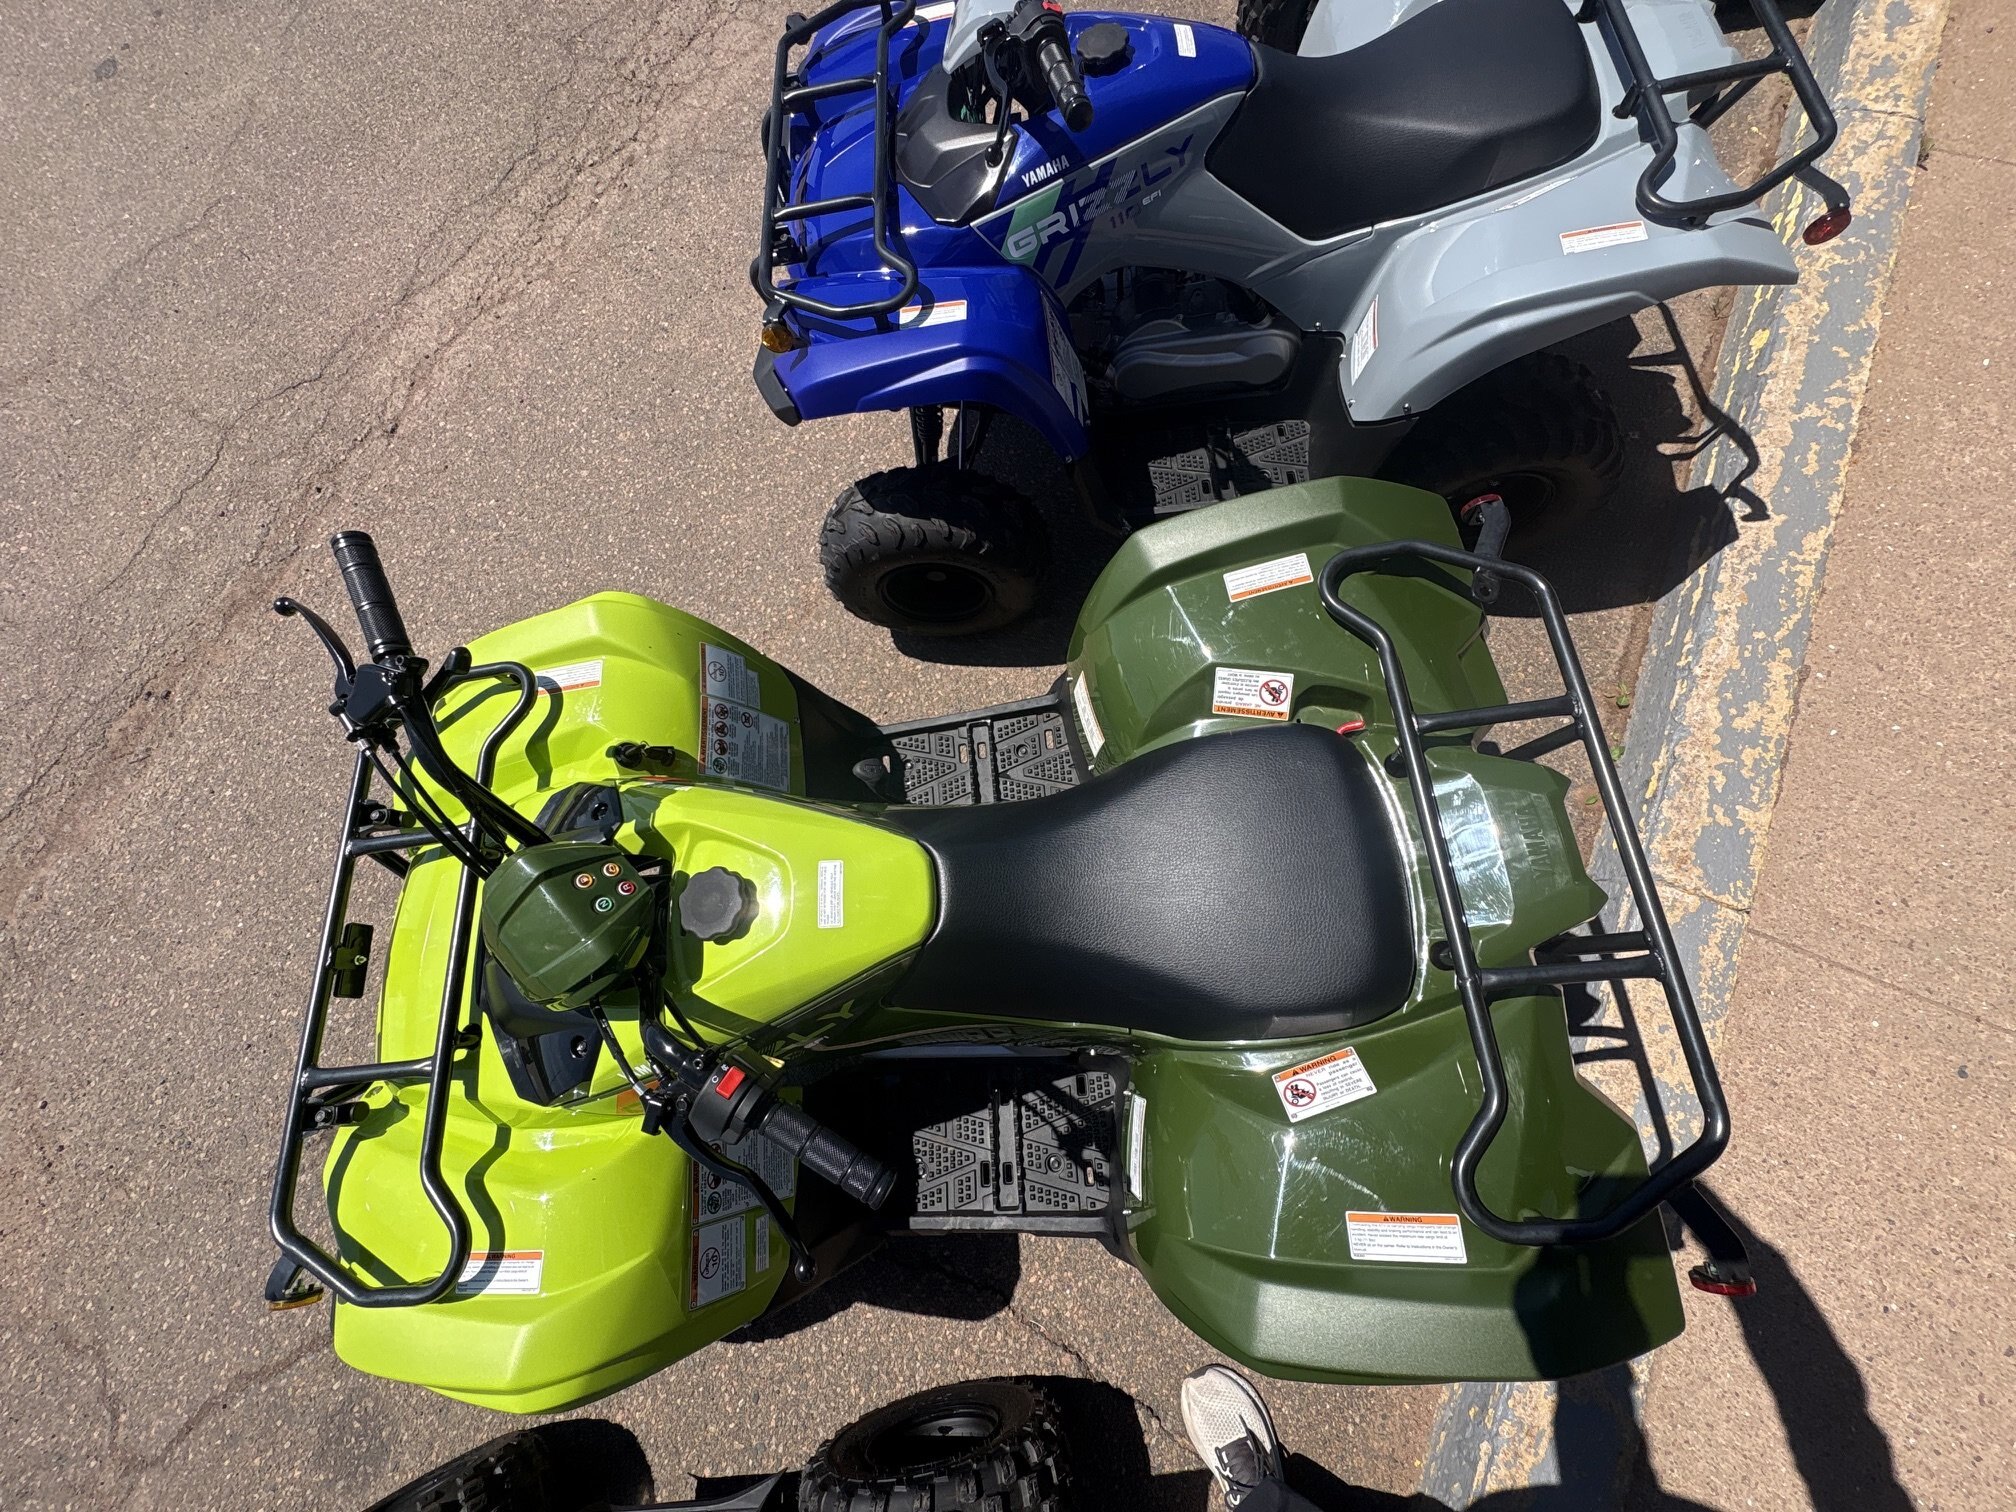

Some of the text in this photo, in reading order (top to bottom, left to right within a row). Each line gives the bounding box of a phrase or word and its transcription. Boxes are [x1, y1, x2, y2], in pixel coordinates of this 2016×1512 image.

[1021, 155, 1070, 188] YAMAHA
[1007, 134, 1194, 258] GRIZZLY
[1142, 189, 1162, 206] EFI
[1216, 705, 1275, 717] AVERTISSEMENT
[1301, 1055, 1337, 1073] WARNING
[1306, 1068, 1326, 1077] NEVER
